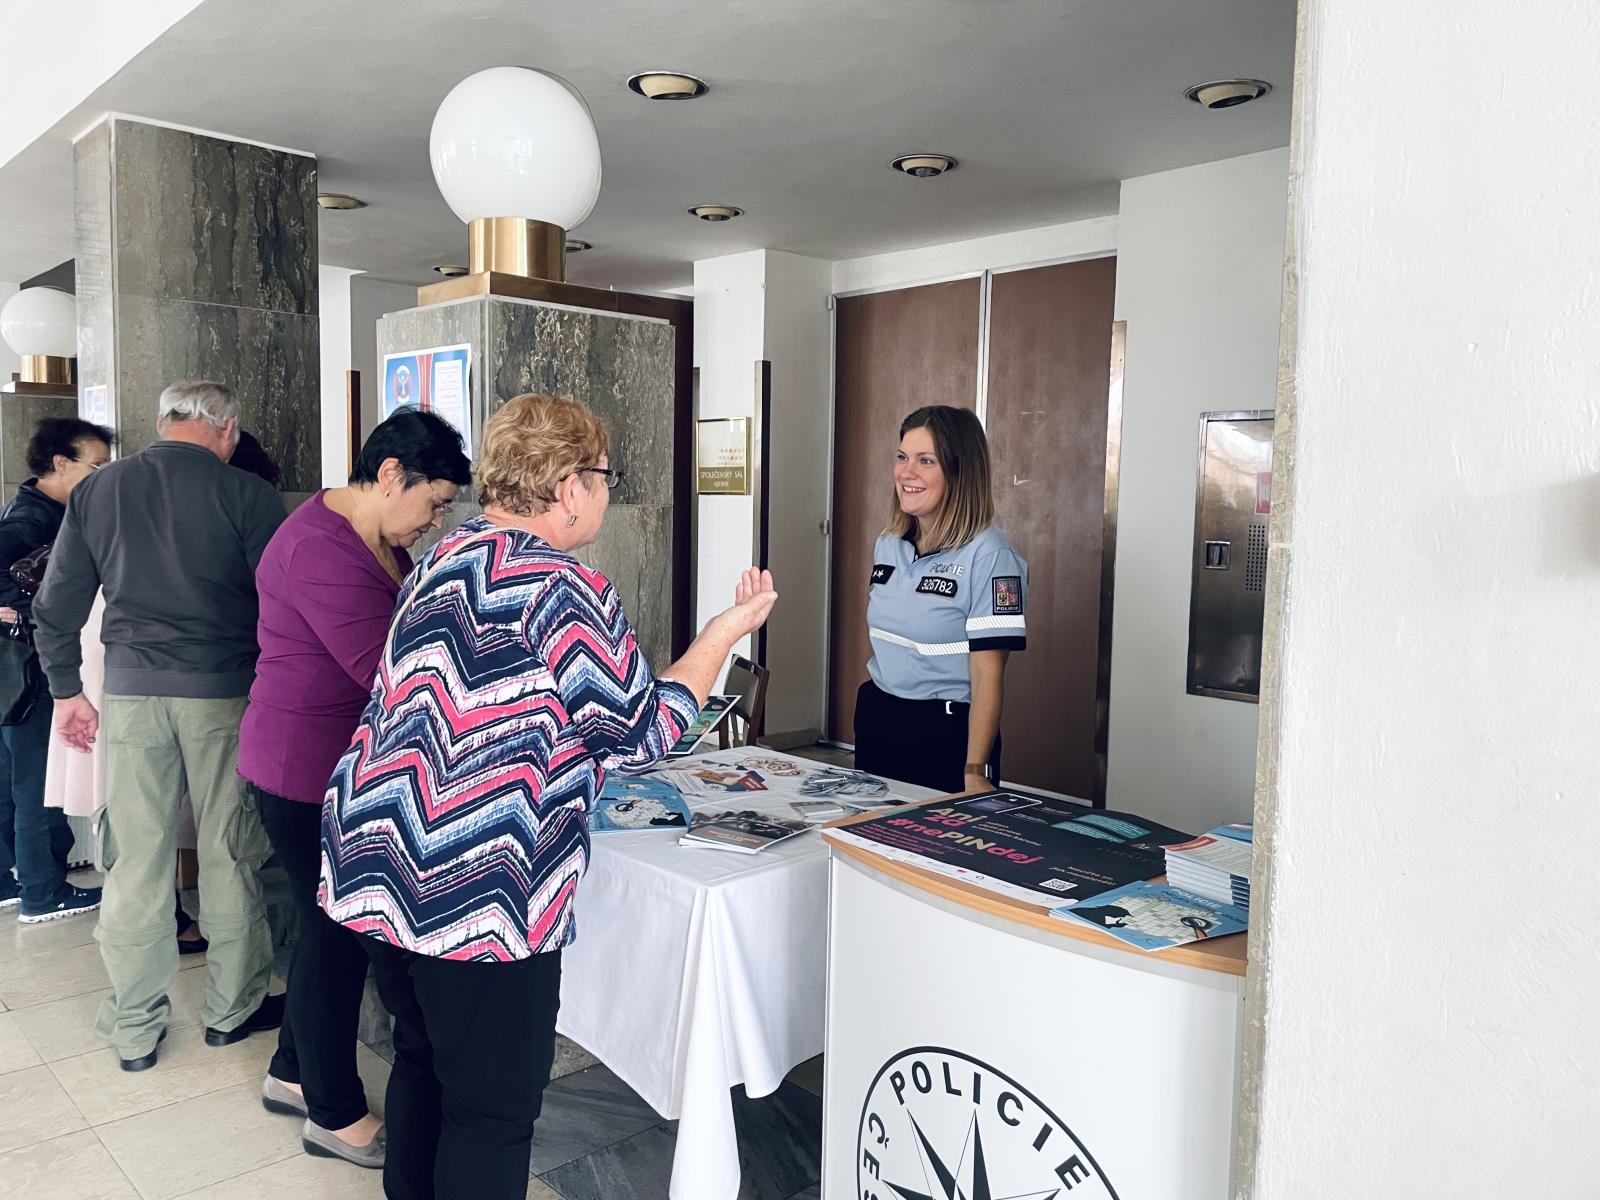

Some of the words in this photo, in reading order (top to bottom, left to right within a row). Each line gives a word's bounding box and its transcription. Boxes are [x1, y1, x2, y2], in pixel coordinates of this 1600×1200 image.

[929, 563, 964, 576] POLICIE
[923, 814, 967, 827] za
[926, 807, 988, 823] Ani
[886, 818, 1045, 864] #nePINdej
[889, 1060, 1091, 1190] POLICIE
